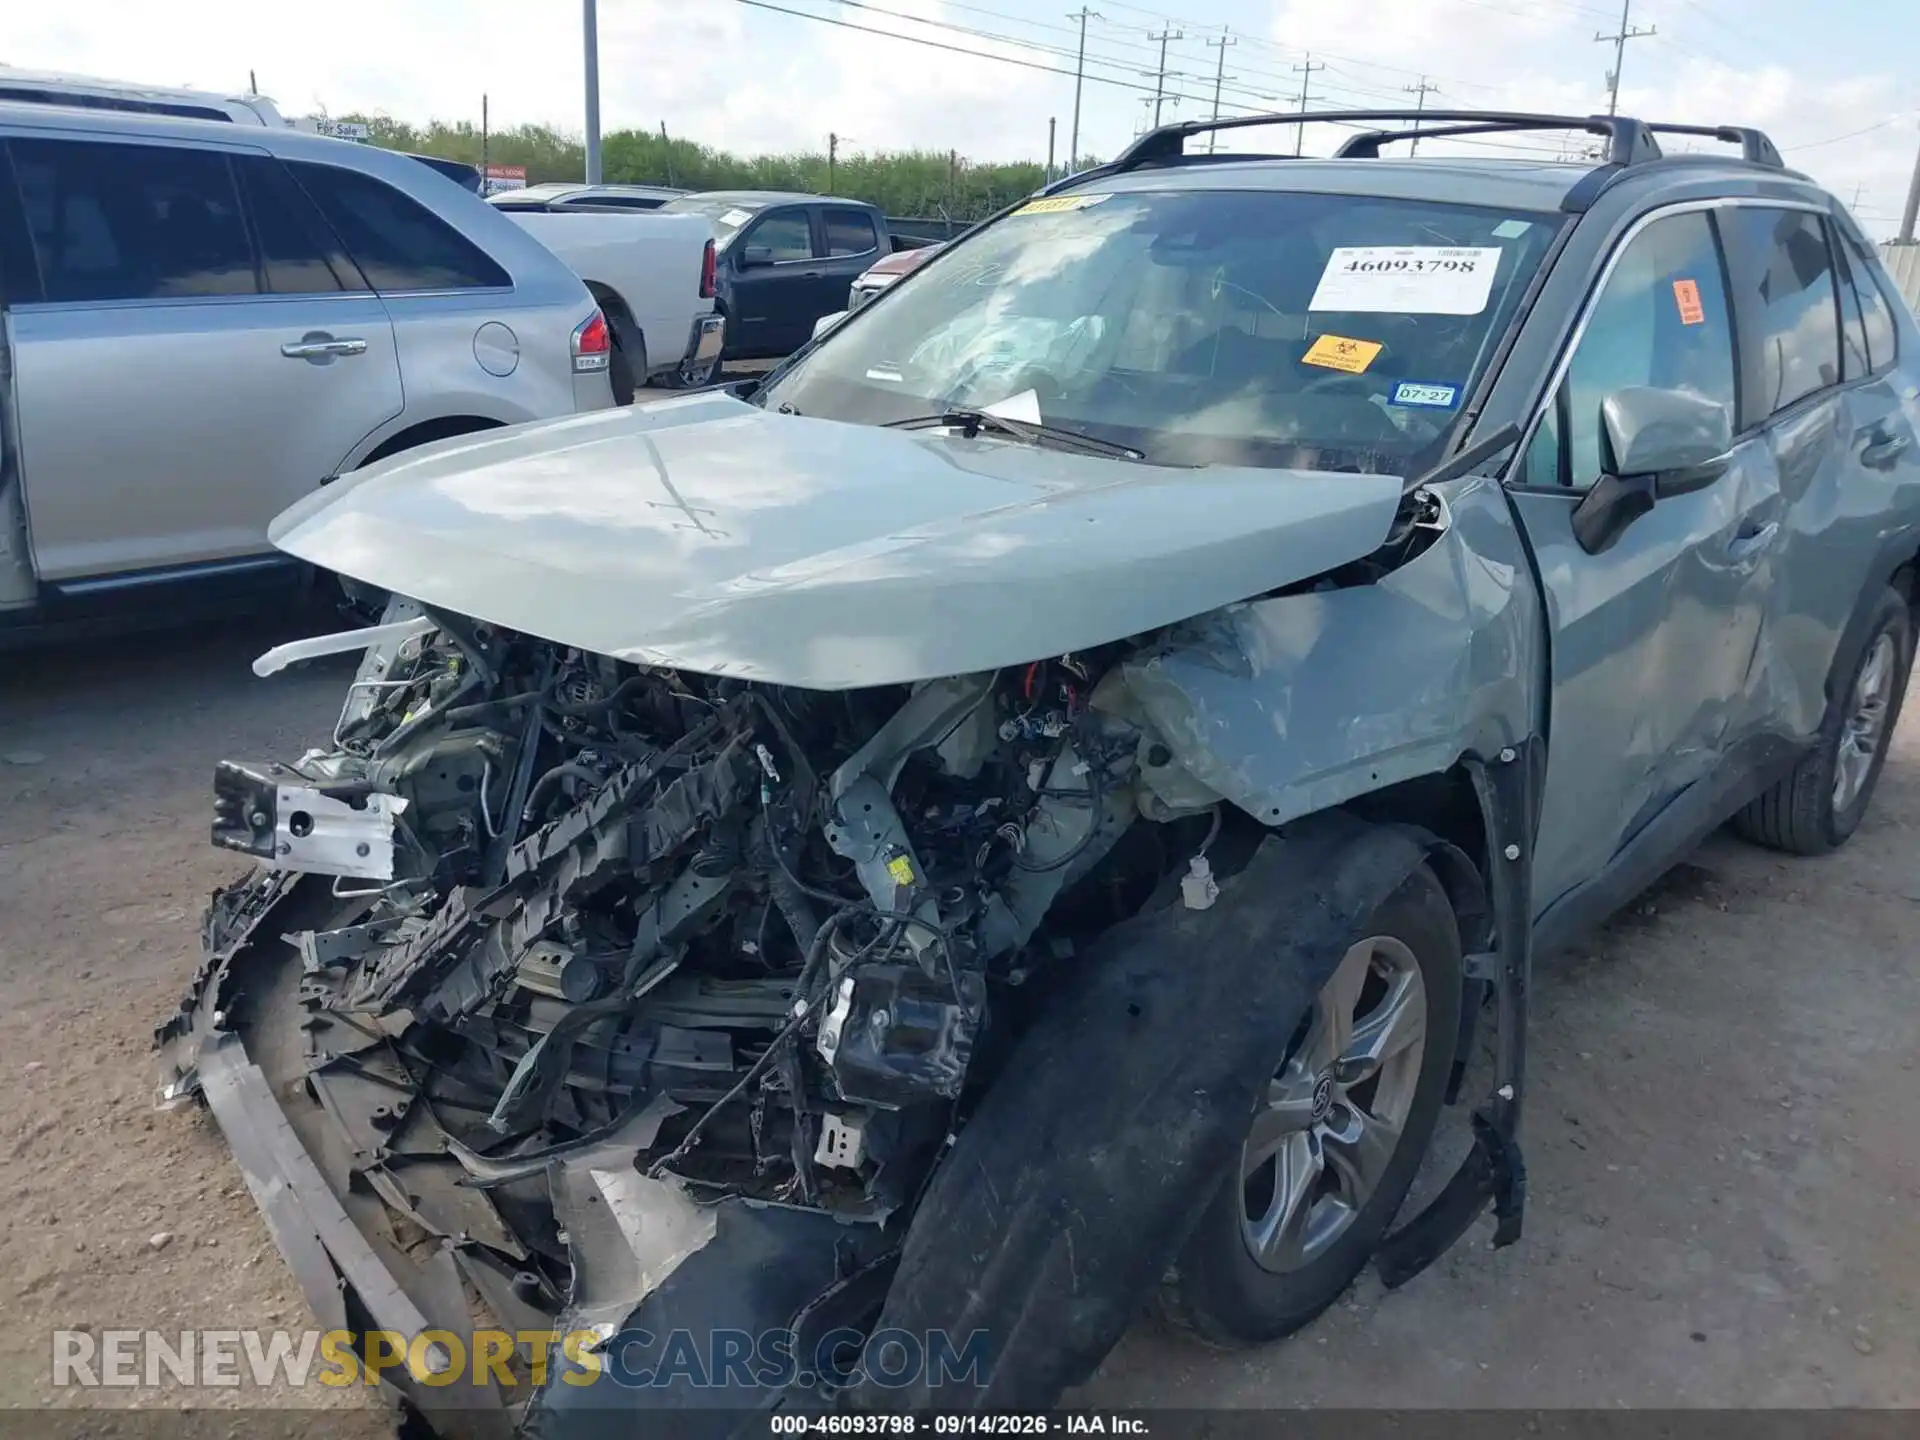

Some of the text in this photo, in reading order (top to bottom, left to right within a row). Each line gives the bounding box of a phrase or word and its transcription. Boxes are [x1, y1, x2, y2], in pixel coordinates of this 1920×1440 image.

[316, 122, 358, 136] For Sale
[1344, 260, 1475, 273] 46093798
